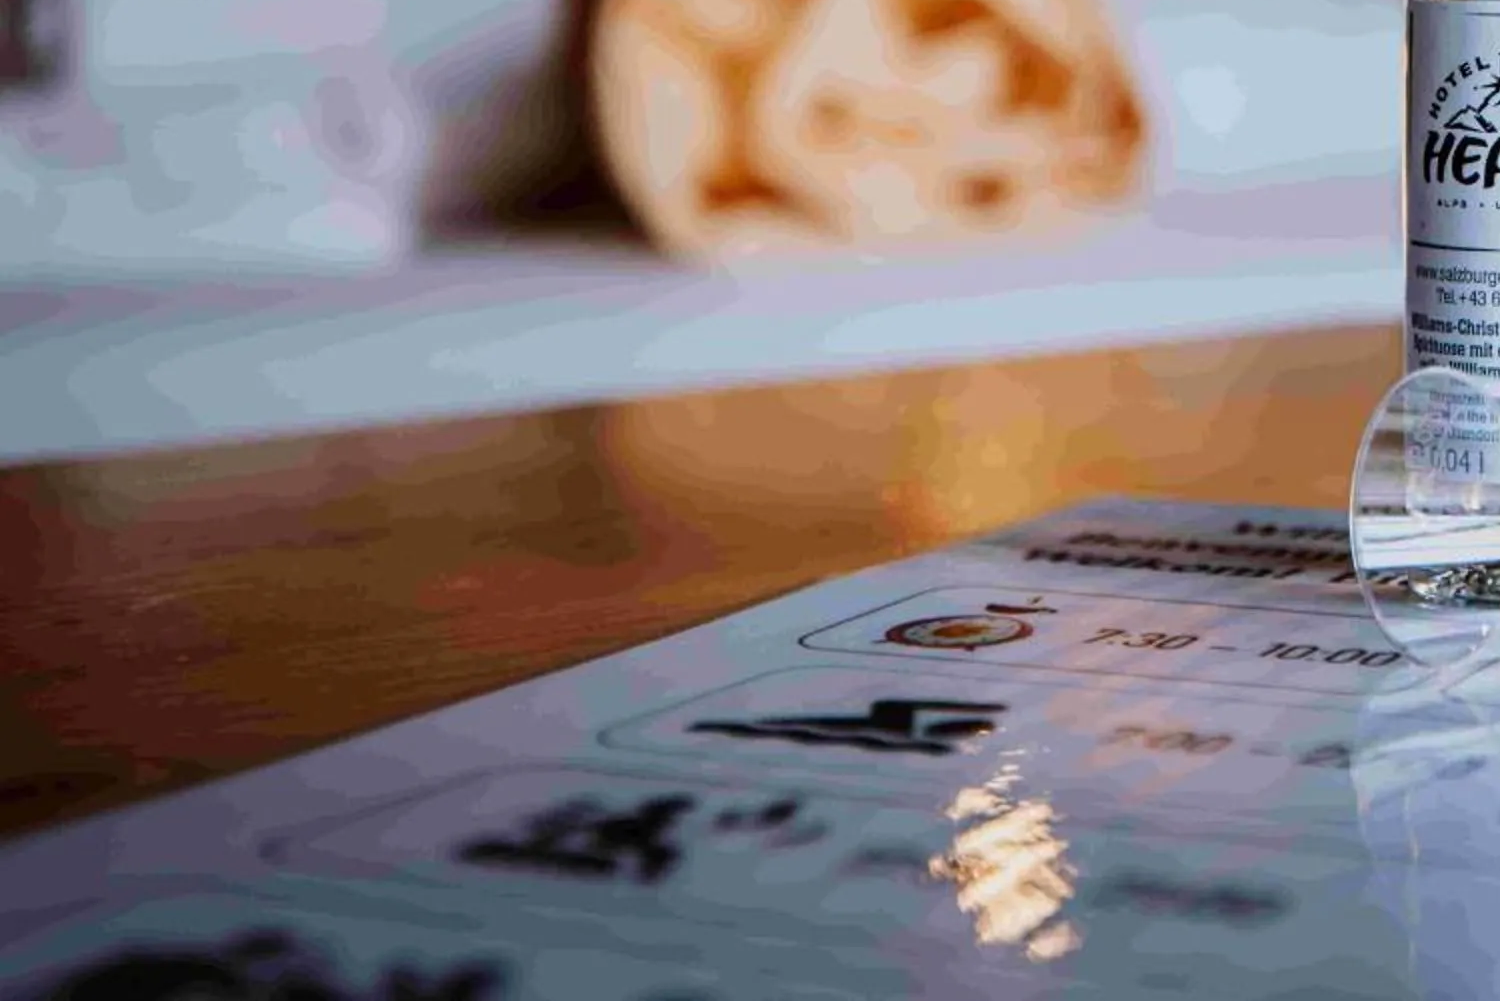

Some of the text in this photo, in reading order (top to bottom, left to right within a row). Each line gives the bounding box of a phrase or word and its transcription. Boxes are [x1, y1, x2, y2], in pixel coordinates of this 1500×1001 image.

[1428, 55, 1490, 120] HOTEL
[1469, 342, 1493, 358] mit
[1083, 627, 1199, 651] 7:30
[1258, 641, 1401, 668] 10:00
